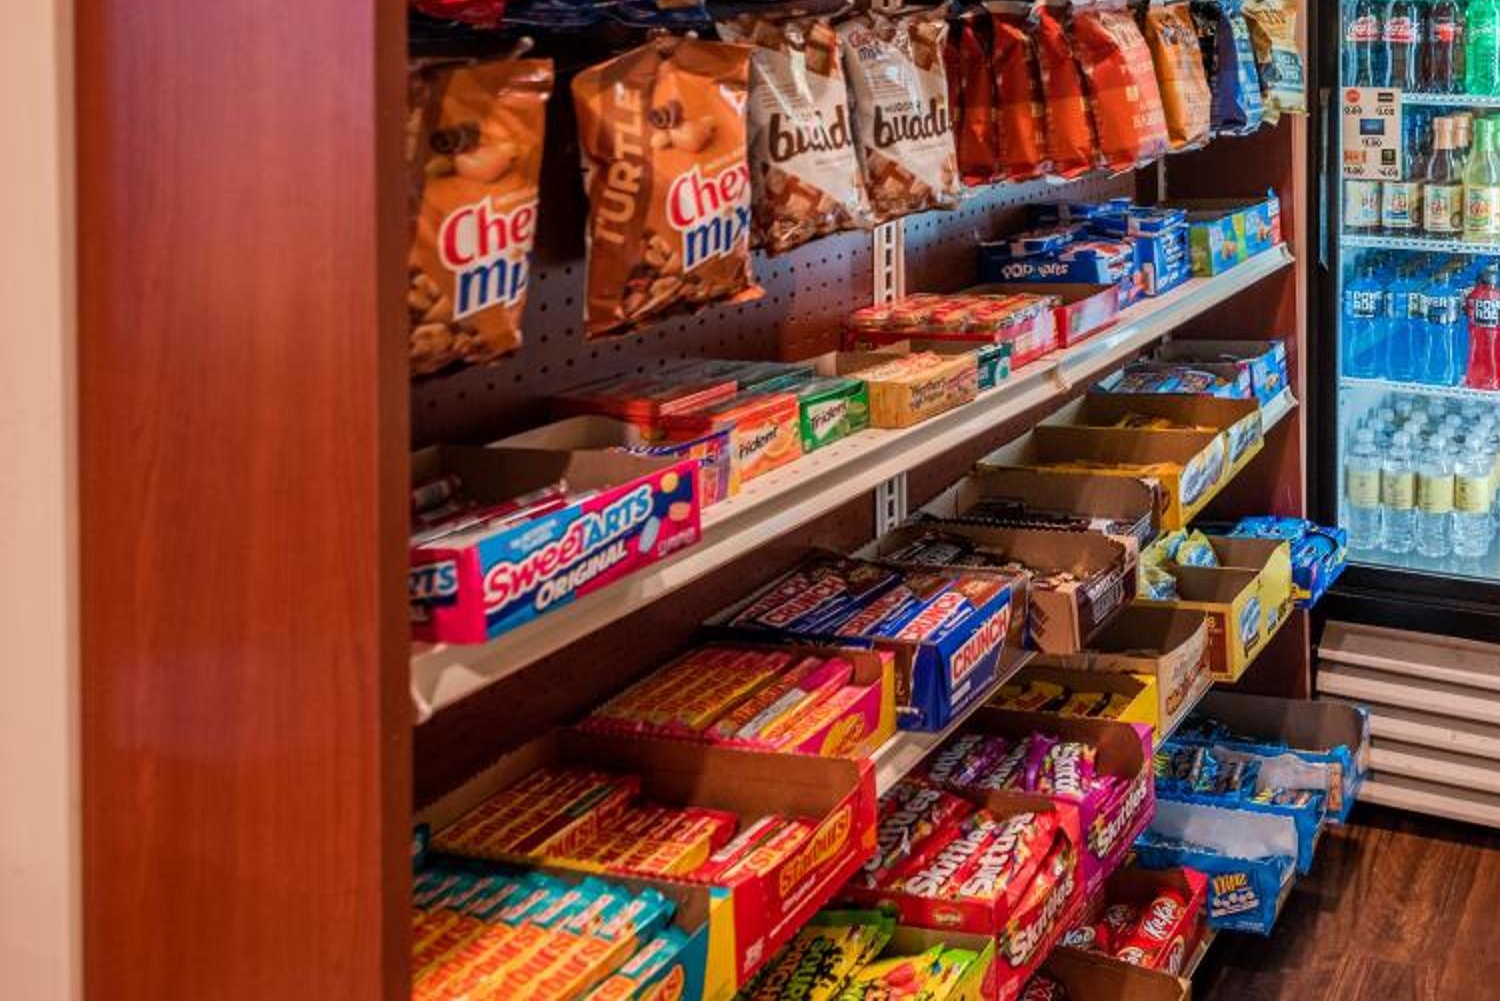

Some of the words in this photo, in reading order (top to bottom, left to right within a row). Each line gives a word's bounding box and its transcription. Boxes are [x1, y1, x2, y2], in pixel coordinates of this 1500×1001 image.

[596, 87, 642, 245] TURTLE
[443, 202, 536, 269] Che
[534, 539, 630, 610] ORIGINAL
[952, 605, 1009, 681] CRUNCH
